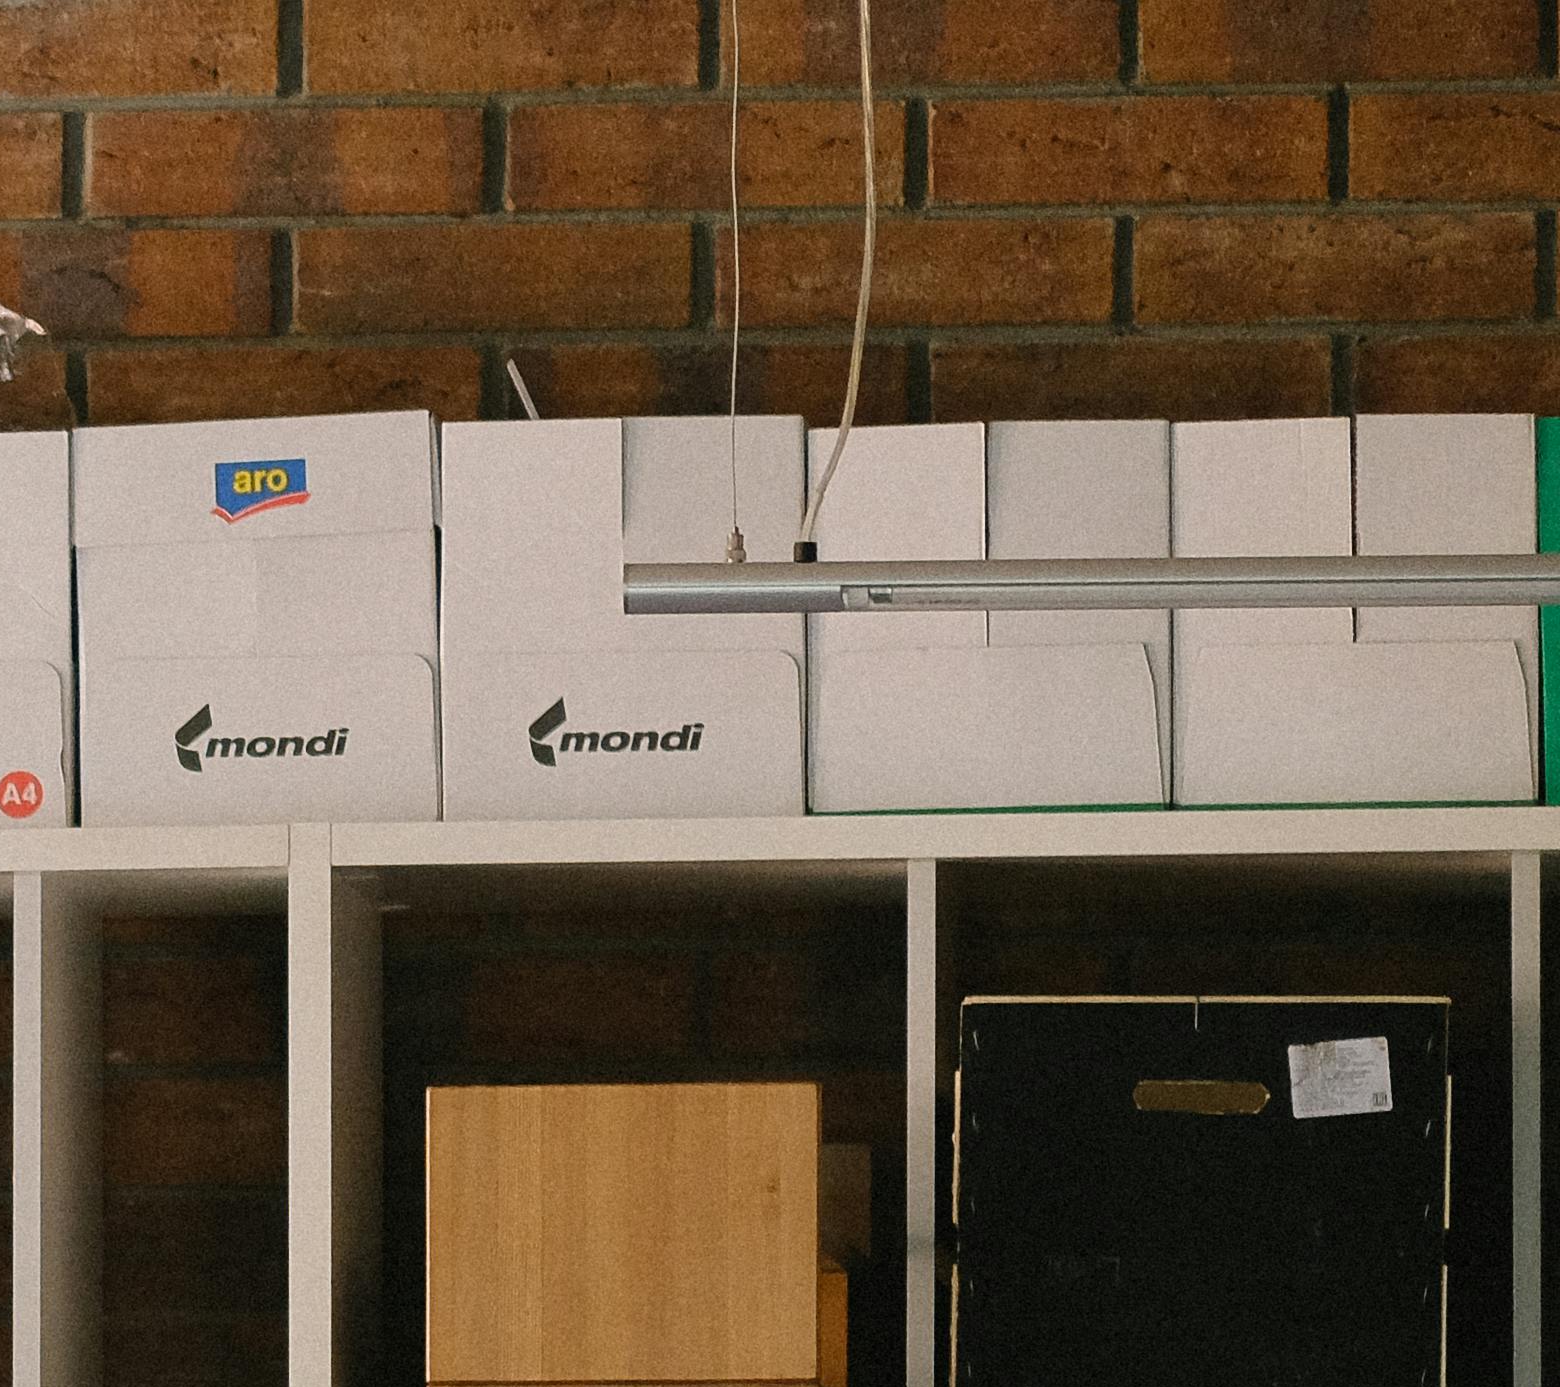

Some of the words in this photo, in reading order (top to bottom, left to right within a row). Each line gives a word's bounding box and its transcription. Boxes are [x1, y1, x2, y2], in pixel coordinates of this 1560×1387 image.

[232, 464, 288, 496] aro
[205, 727, 350, 761] mondi
[560, 722, 705, 753] mondi
[1, 781, 37, 805] A4
